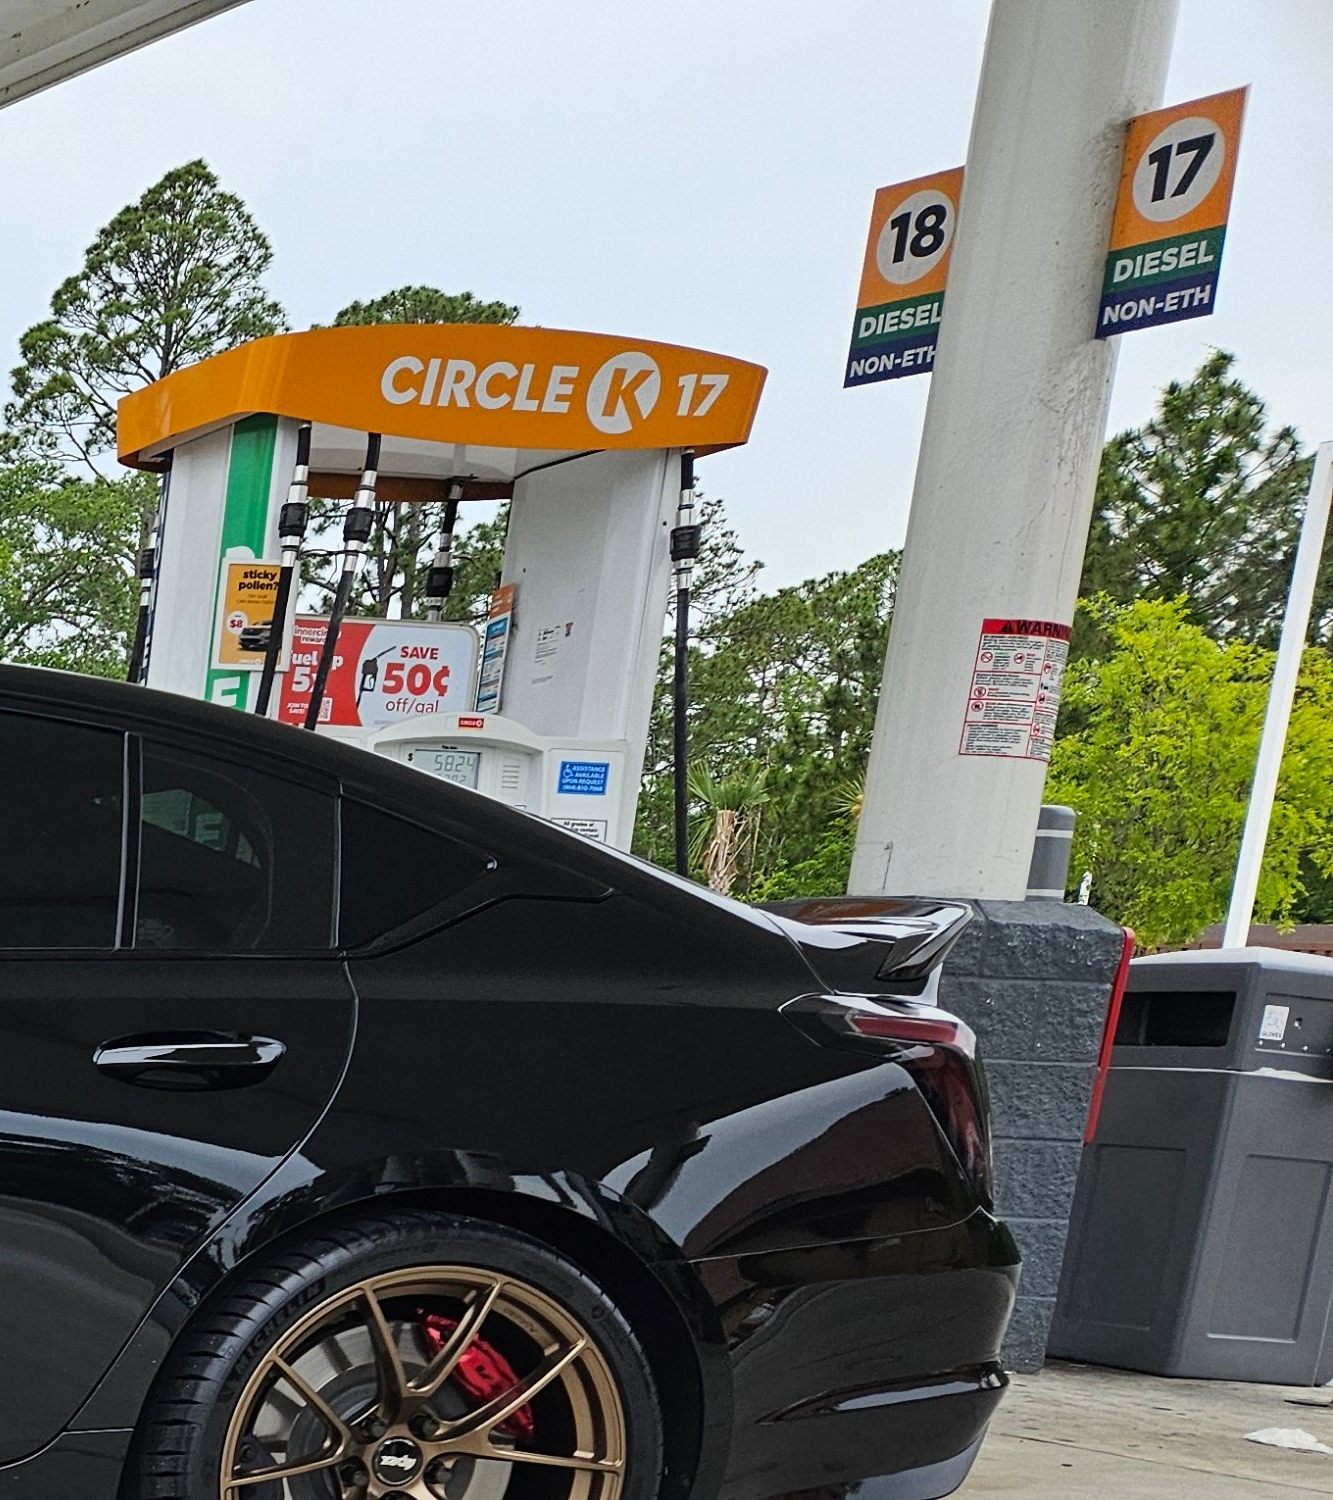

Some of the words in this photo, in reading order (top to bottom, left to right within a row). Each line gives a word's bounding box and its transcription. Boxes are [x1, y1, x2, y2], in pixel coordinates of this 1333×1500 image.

[1148, 132, 1216, 203] 17
[890, 203, 948, 264] 18
[1113, 239, 1214, 283] DIESEL
[1102, 284, 1212, 326] NON-ETH
[858, 302, 942, 339] DIESEL
[380, 355, 580, 414] CIRCLE
[676, 372, 730, 418] 17
[237, 580, 279, 592] pollen?
[242, 569, 278, 582] sticky
[229, 619, 243, 628] $8
[1016, 619, 1071, 640] WARN
[290, 650, 317, 666] uel
[400, 645, 439, 660] SAVE
[382, 662, 451, 697] 50¢
[385, 698, 439, 714] off/gal
